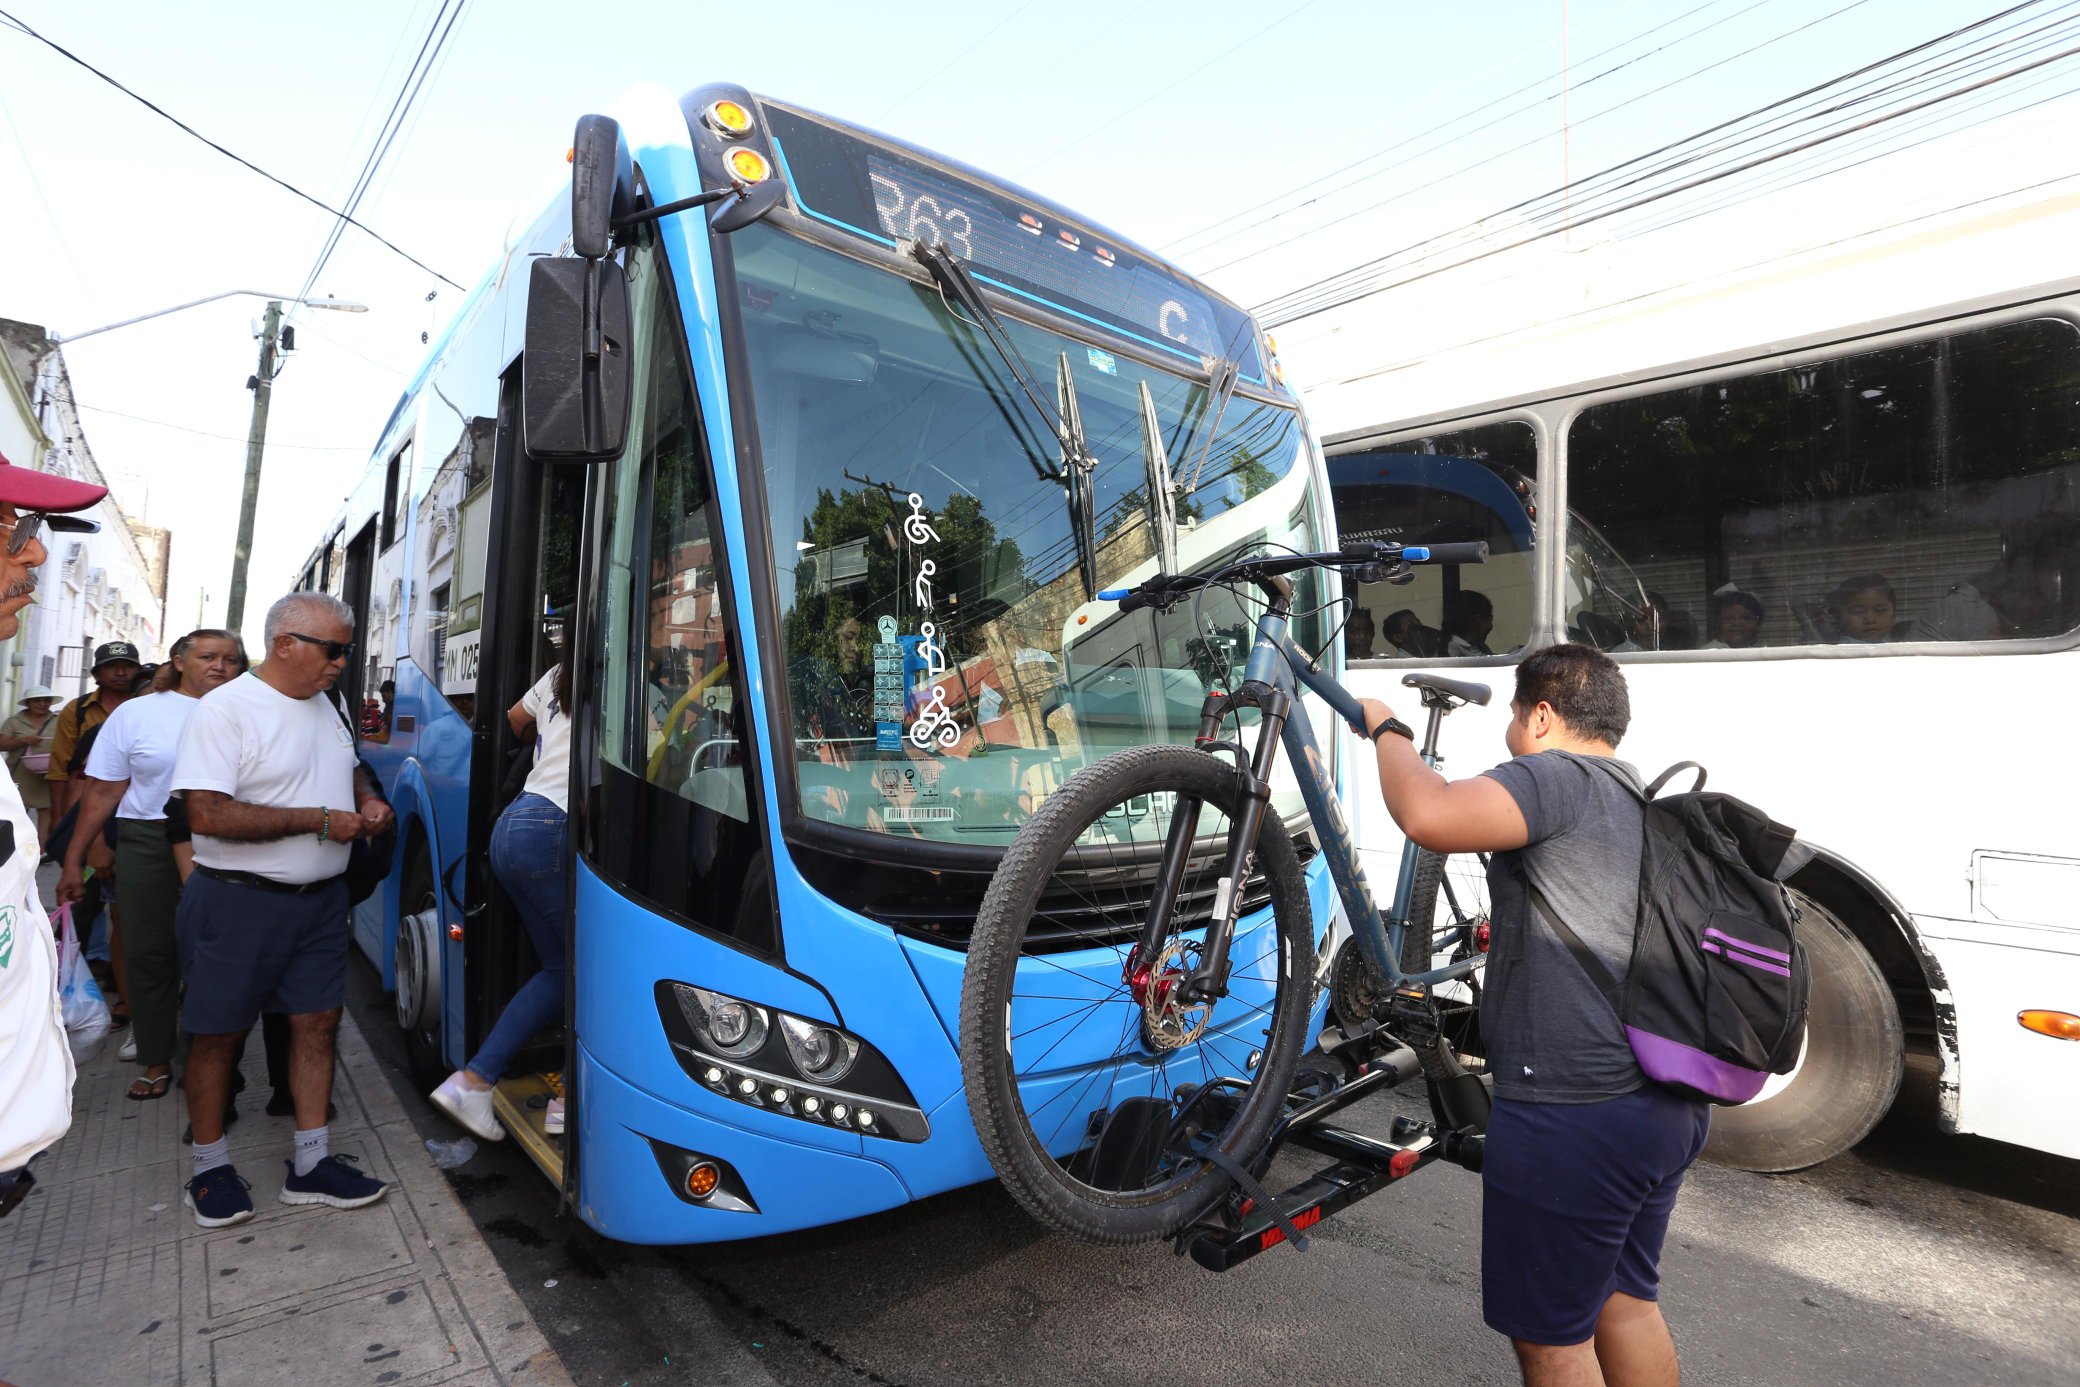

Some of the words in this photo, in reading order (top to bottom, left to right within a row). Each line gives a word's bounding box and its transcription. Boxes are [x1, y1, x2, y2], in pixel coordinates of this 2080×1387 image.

[869, 172, 972, 261] R63
[1159, 300, 1189, 344] C
[461, 642, 480, 681] 025
[1225, 849, 1256, 938] ZIGNA
